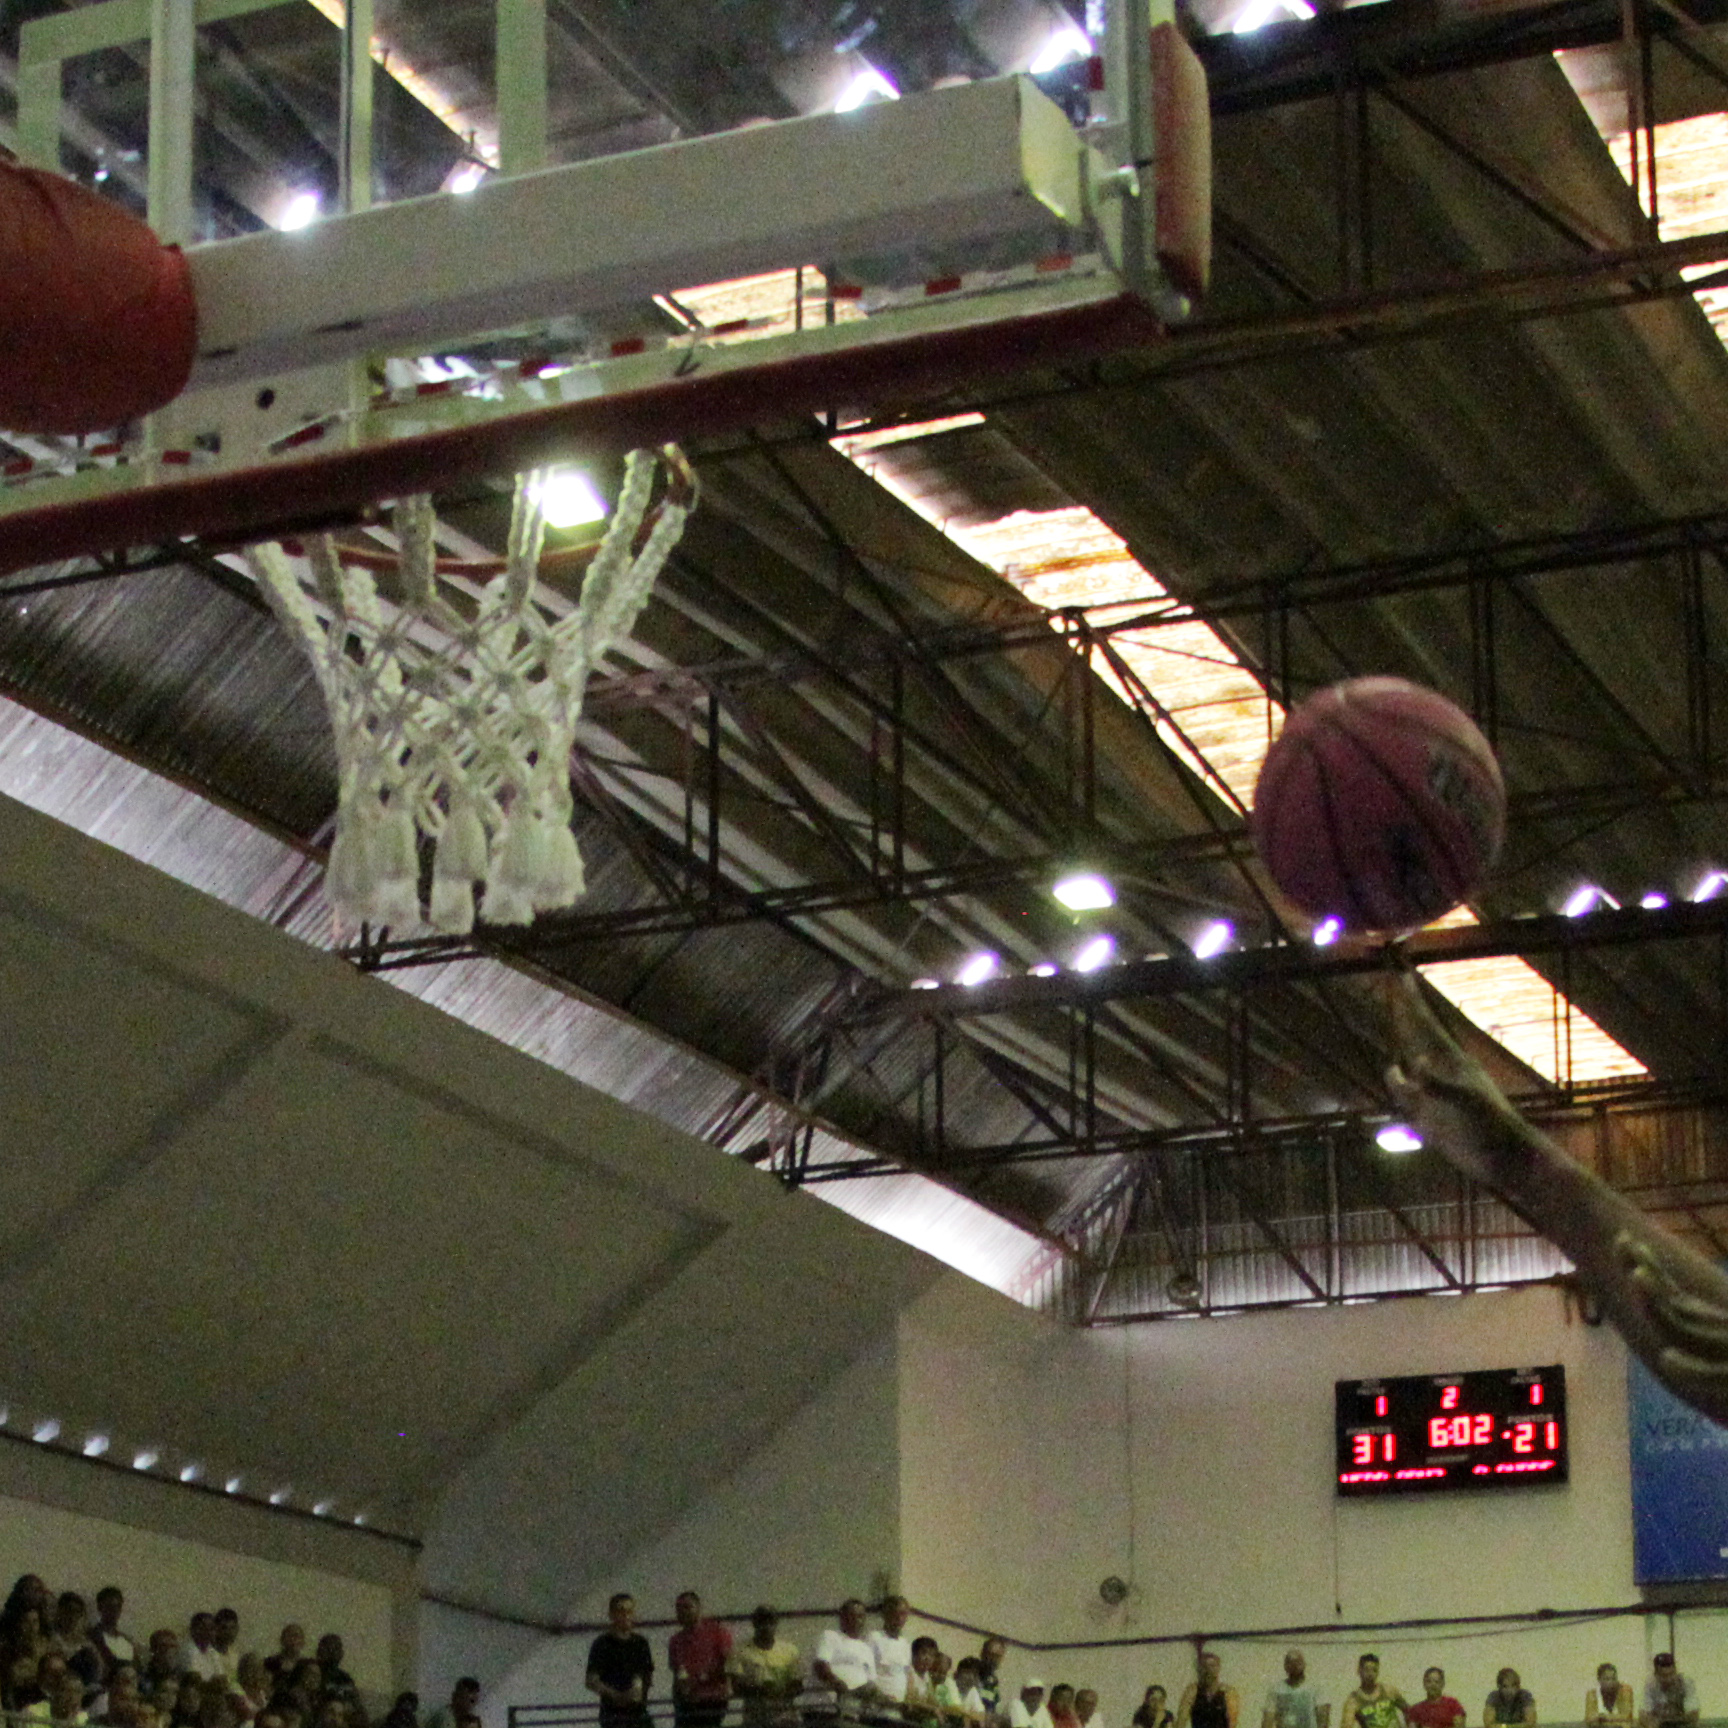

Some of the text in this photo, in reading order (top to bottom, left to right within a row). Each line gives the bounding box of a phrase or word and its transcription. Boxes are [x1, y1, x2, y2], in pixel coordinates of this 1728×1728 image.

[1440, 1385, 1460, 1409] 2
[1530, 1383, 1543, 1405] 1
[1375, 1396, 1388, 1417] 1
[1513, 1421, 1559, 1453] 21
[1352, 1434, 1396, 1465] 31
